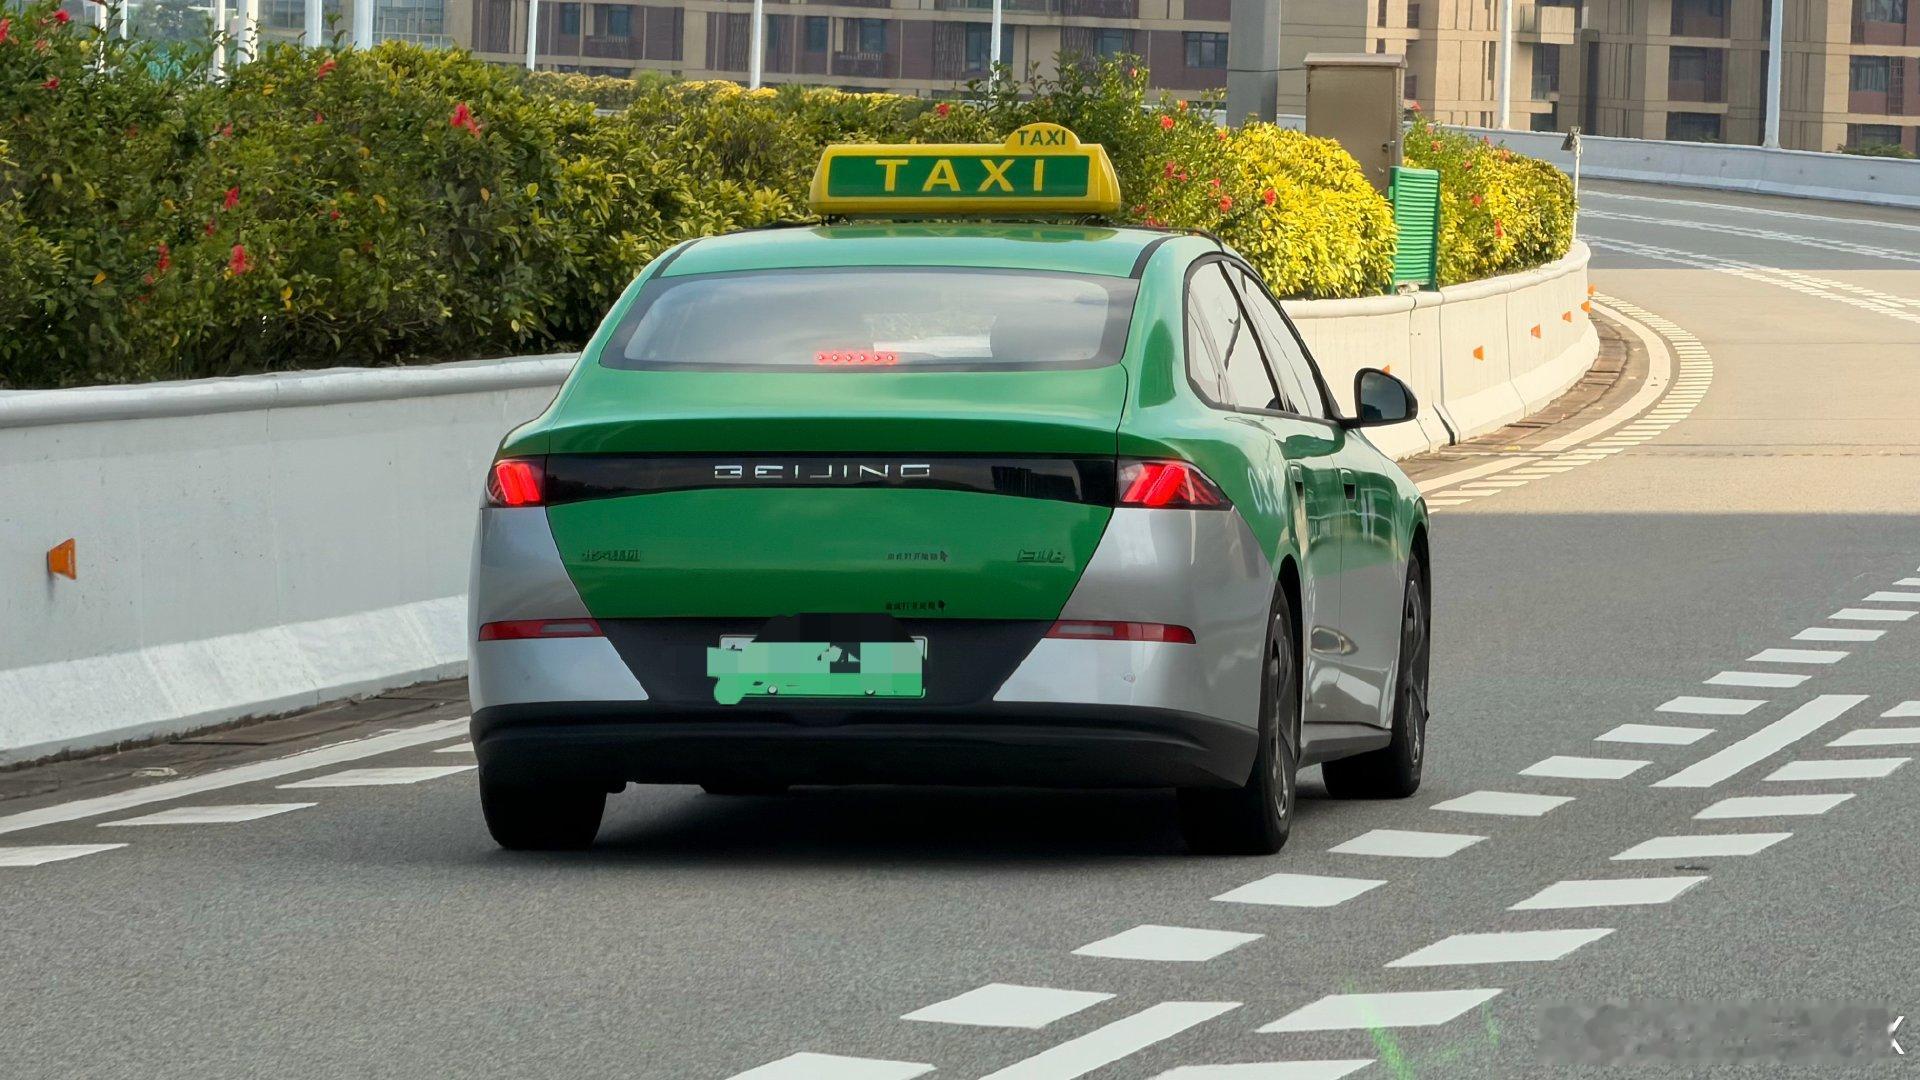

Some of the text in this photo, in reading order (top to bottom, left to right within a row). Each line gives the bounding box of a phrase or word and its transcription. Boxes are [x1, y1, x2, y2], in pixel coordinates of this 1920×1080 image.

[1017, 129, 1066, 146] TAXI
[875, 159, 1044, 192] TAXI
[714, 464, 930, 479] BEIJING
